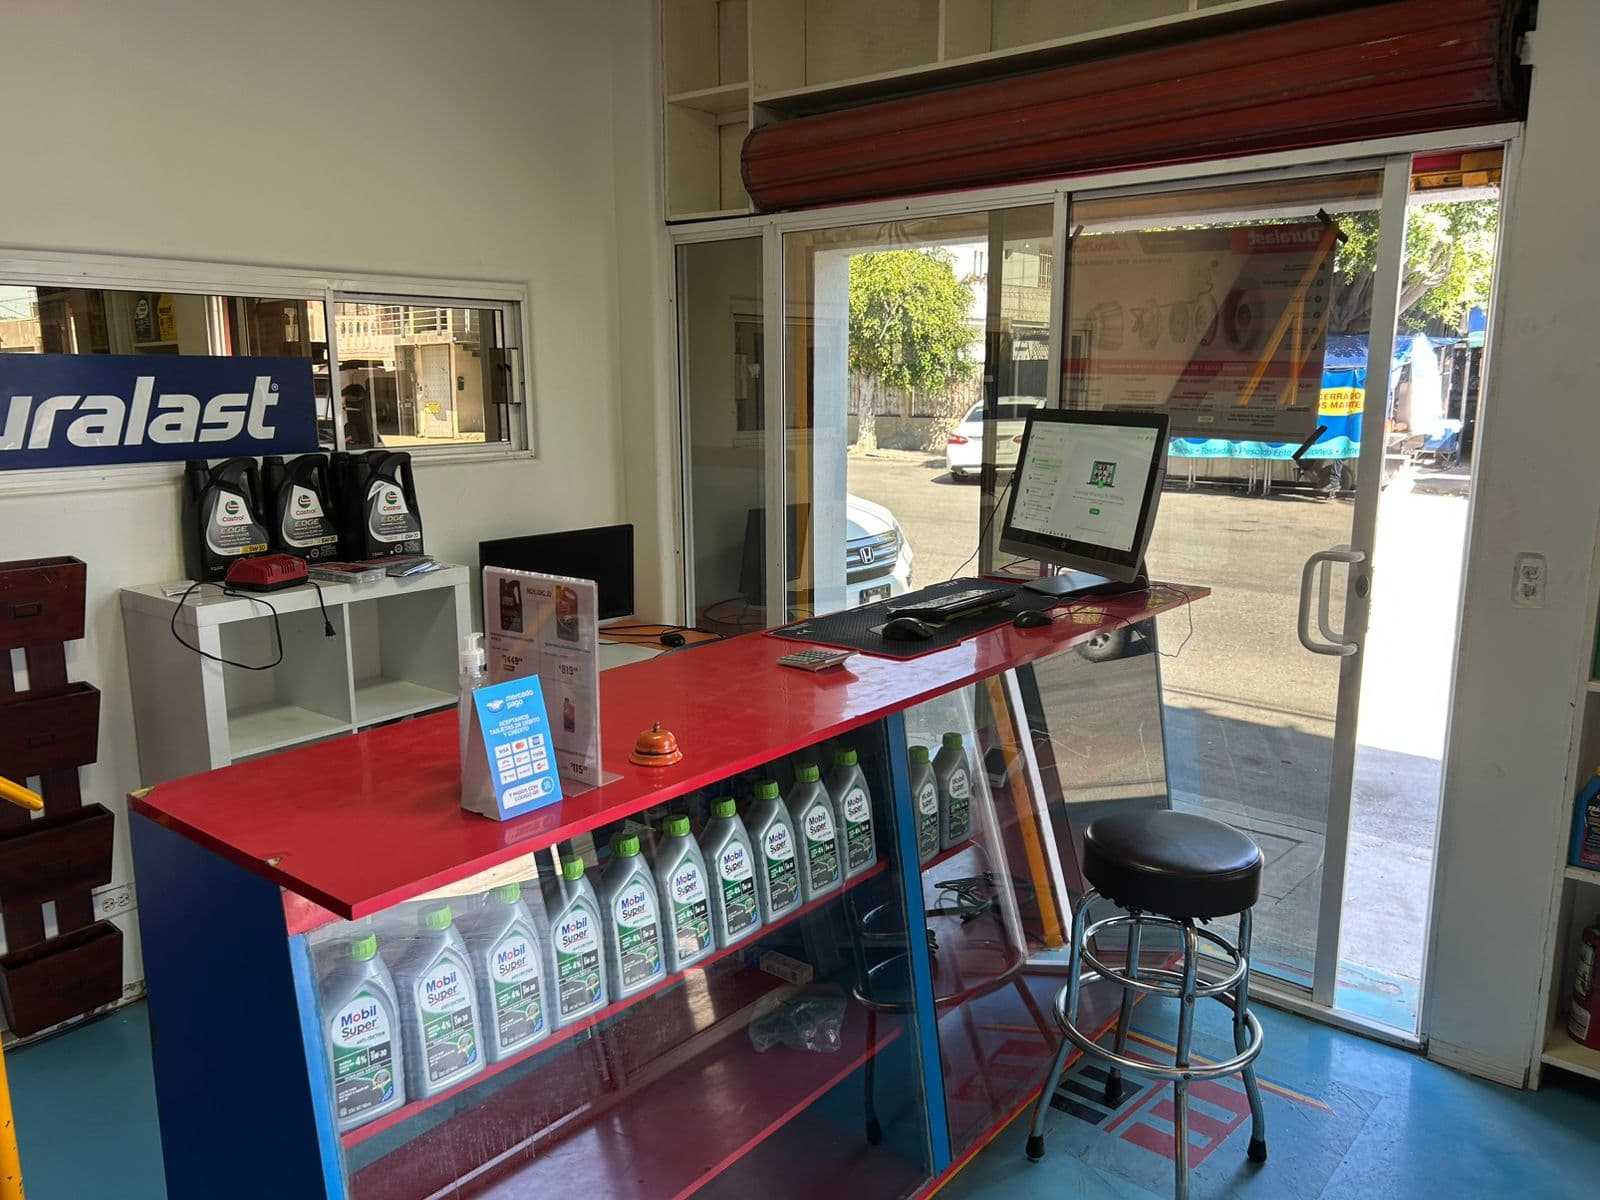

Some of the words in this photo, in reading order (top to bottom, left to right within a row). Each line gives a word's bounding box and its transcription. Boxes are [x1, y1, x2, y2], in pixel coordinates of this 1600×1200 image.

[222, 515, 245, 523] Castrol
[295, 508, 317, 516] Castrol
[221, 525, 249, 534] EDGE
[505, 689, 534, 702] mercado
[507, 699, 524, 710] pago
[809, 812, 826, 825] Mobil
[768, 829, 786, 844] Mobil
[770, 840, 787, 853] Super
[724, 848, 743, 865] Mobil
[725, 859, 744, 873] Super
[676, 870, 697, 886] Mobil
[677, 881, 697, 896] Super
[621, 892, 646, 910] Mobil
[622, 904, 646, 919] Super
[561, 917, 588, 936] Mobil
[562, 929, 588, 946] Super
[498, 944, 526, 964] Mobil
[499, 957, 527, 975] Super
[426, 972, 457, 993] Mobil
[427, 985, 458, 1005] Super
[341, 1005, 377, 1028] Mobil
[342, 1018, 378, 1040] Super
[355, 1054, 367, 1067] 4%
